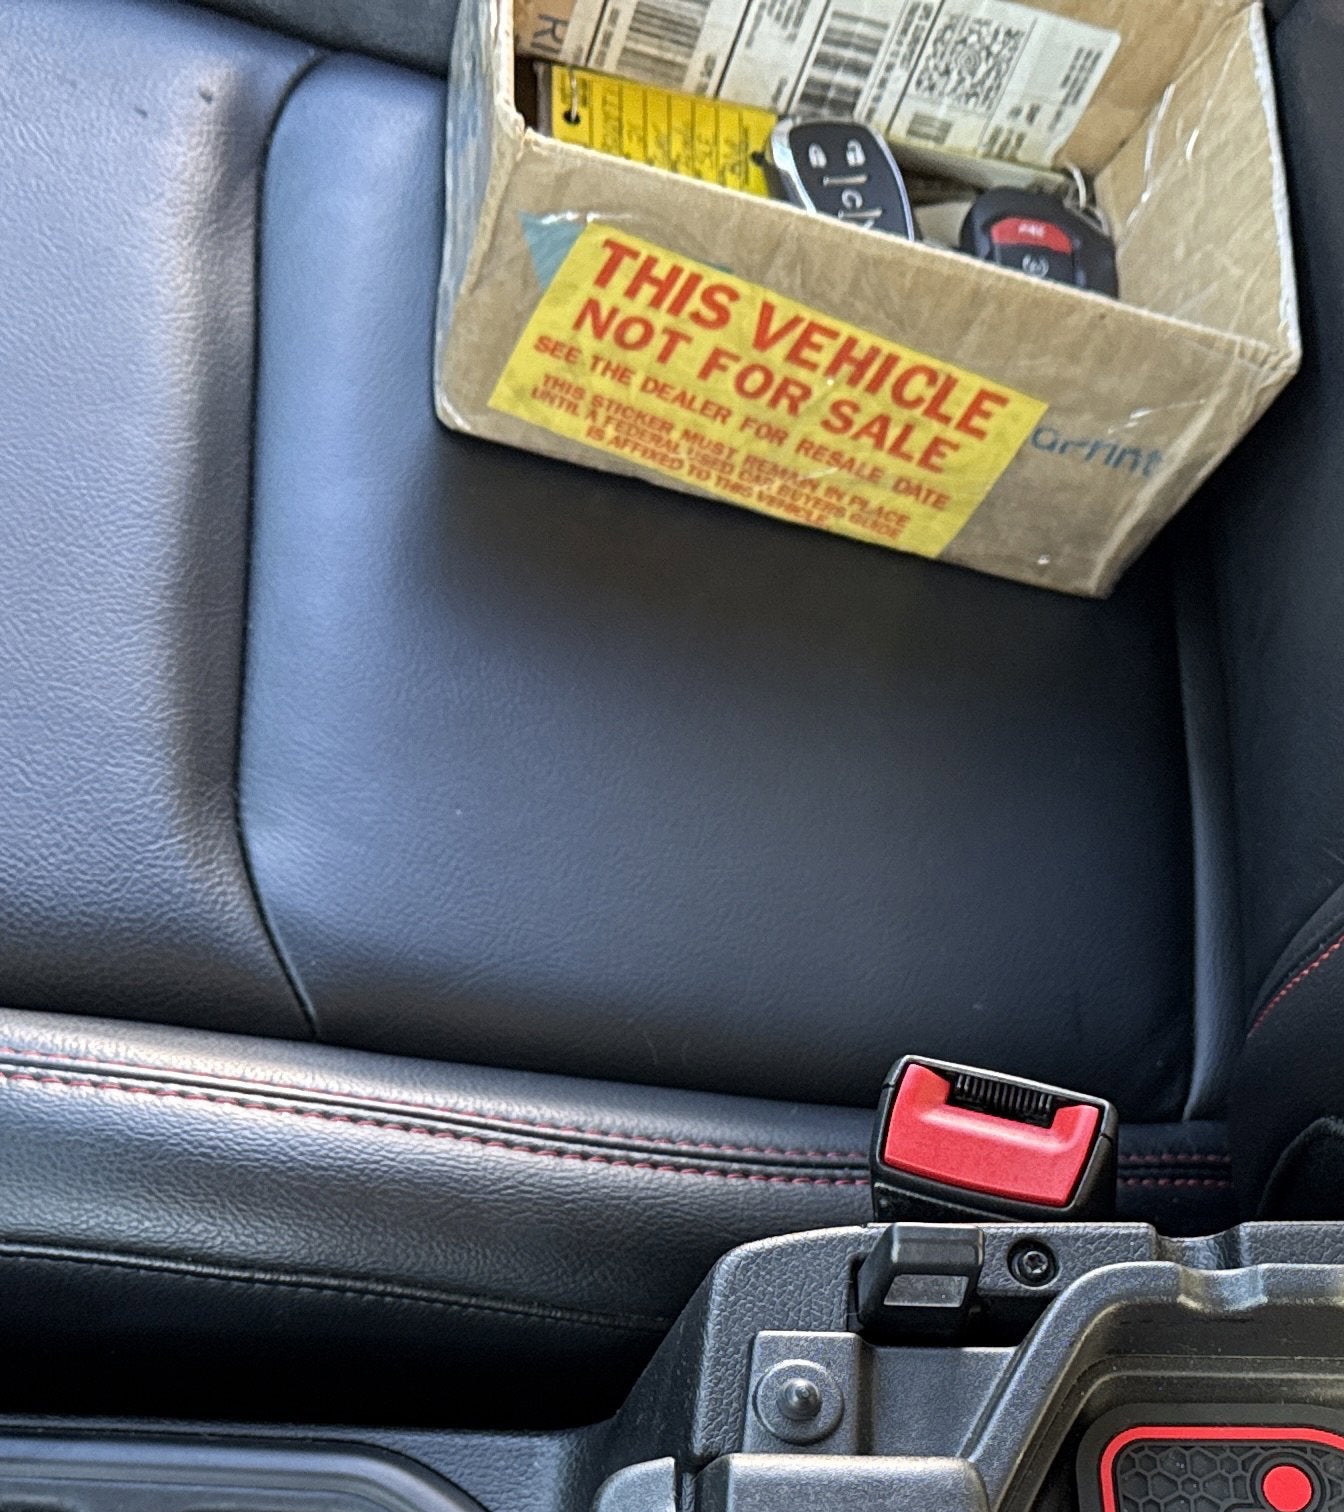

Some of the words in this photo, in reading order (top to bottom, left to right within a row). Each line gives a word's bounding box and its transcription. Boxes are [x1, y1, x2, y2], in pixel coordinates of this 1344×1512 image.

[572, 297, 692, 365] NOT
[697, 347, 813, 417] FOR
[820, 399, 961, 474] SALE
[593, 238, 740, 330] THIS
[752, 300, 1009, 441] VEHICLE
[531, 386, 581, 417] UNTIL
[585, 406, 597, 424] A
[603, 415, 680, 454] FEDERAL
[686, 446, 735, 475] USED
[776, 483, 846, 518] BUYERS
[847, 512, 904, 542] GUIDE
[533, 335, 582, 365] SEE
[590, 354, 637, 385] THE
[640, 376, 733, 421] DEALER
[738, 416, 790, 447] FOR
[794, 437, 884, 484] RESALE
[891, 475, 952, 512] DATE
[543, 373, 586, 400] THIS
[591, 394, 675, 434] STICKER
[680, 428, 738, 460] MUST
[741, 454, 821, 493] REMAIN
[823, 485, 847, 502] IN
[848, 494, 911, 528] PLACE
[586, 424, 606, 442] IS
[607, 434, 685, 470] AFFIXED
[687, 463, 712, 482] TO
[714, 474, 754, 498] THIS
